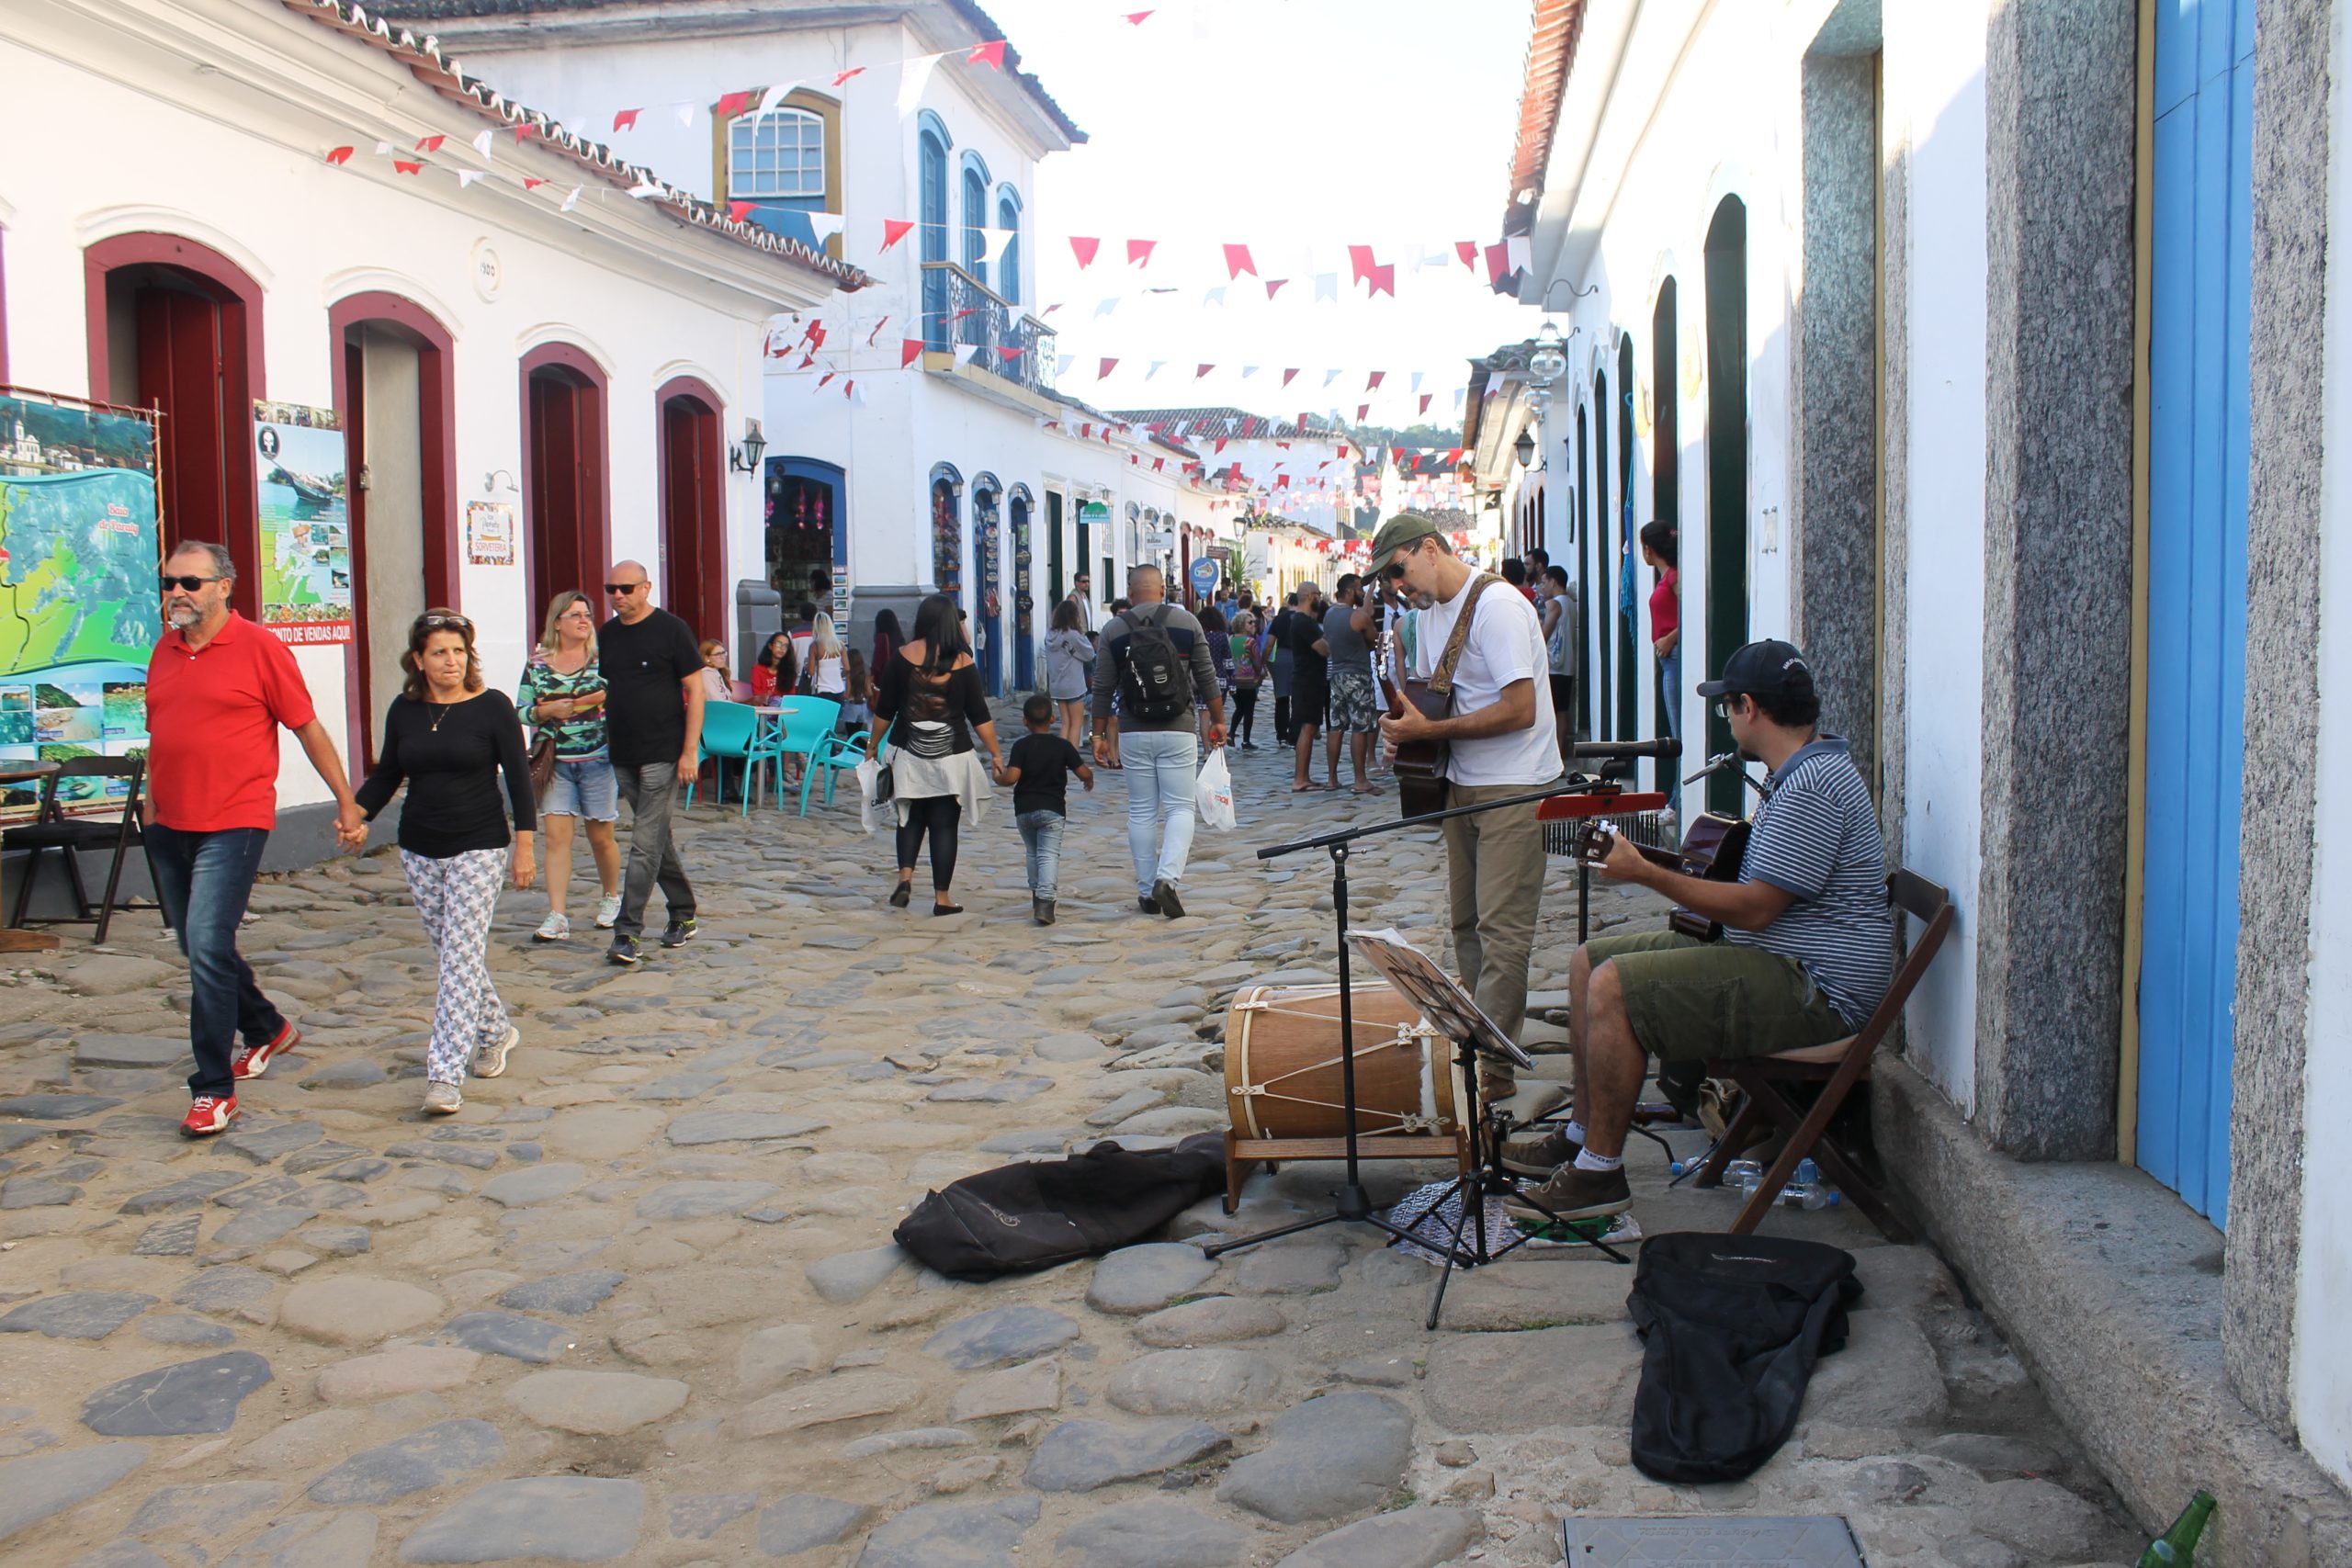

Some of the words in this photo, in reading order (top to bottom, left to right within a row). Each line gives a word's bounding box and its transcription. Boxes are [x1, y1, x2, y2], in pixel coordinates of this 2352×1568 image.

[293, 627, 304, 642] DE
[304, 626, 331, 641] VENDAS
[1584, 1149, 1618, 1164] SPORT
